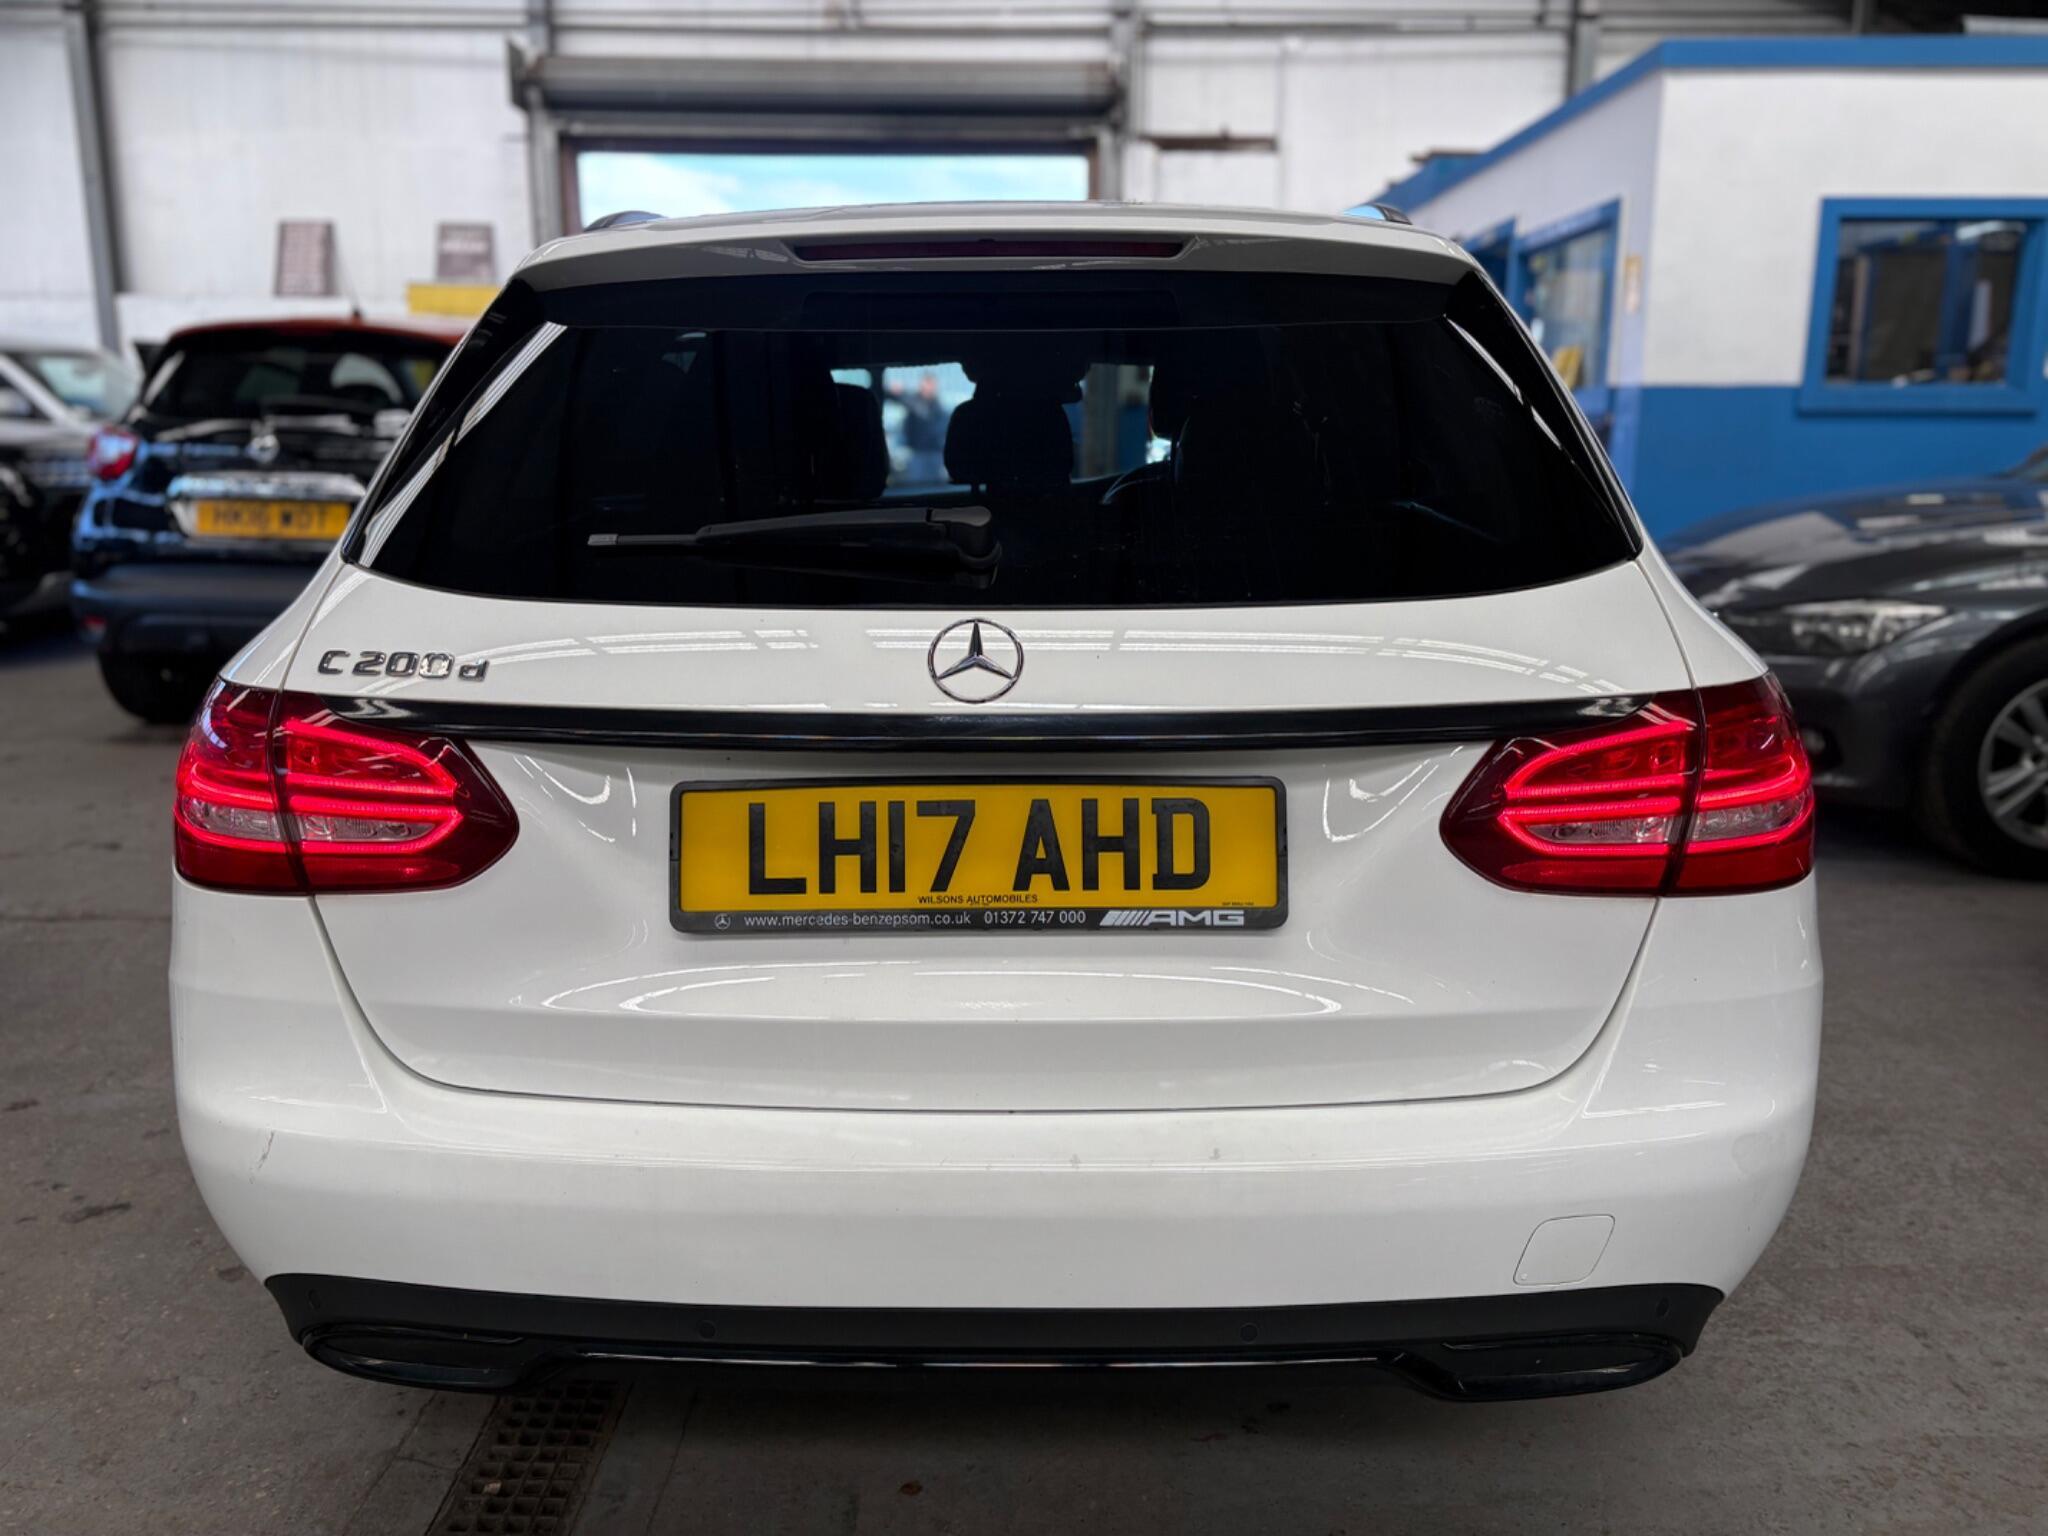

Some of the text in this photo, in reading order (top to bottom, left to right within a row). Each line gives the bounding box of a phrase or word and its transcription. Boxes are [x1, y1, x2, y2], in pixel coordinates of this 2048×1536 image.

[318, 650, 349, 675] C
[749, 797, 1211, 894] LH17 AHD
[917, 894, 1038, 904] WILSONS AUTOMOBILES
[744, 910, 1086, 928] www.mercedes-benzepsom.co.uk 01372 747 000
[1144, 910, 1245, 926] AMG
